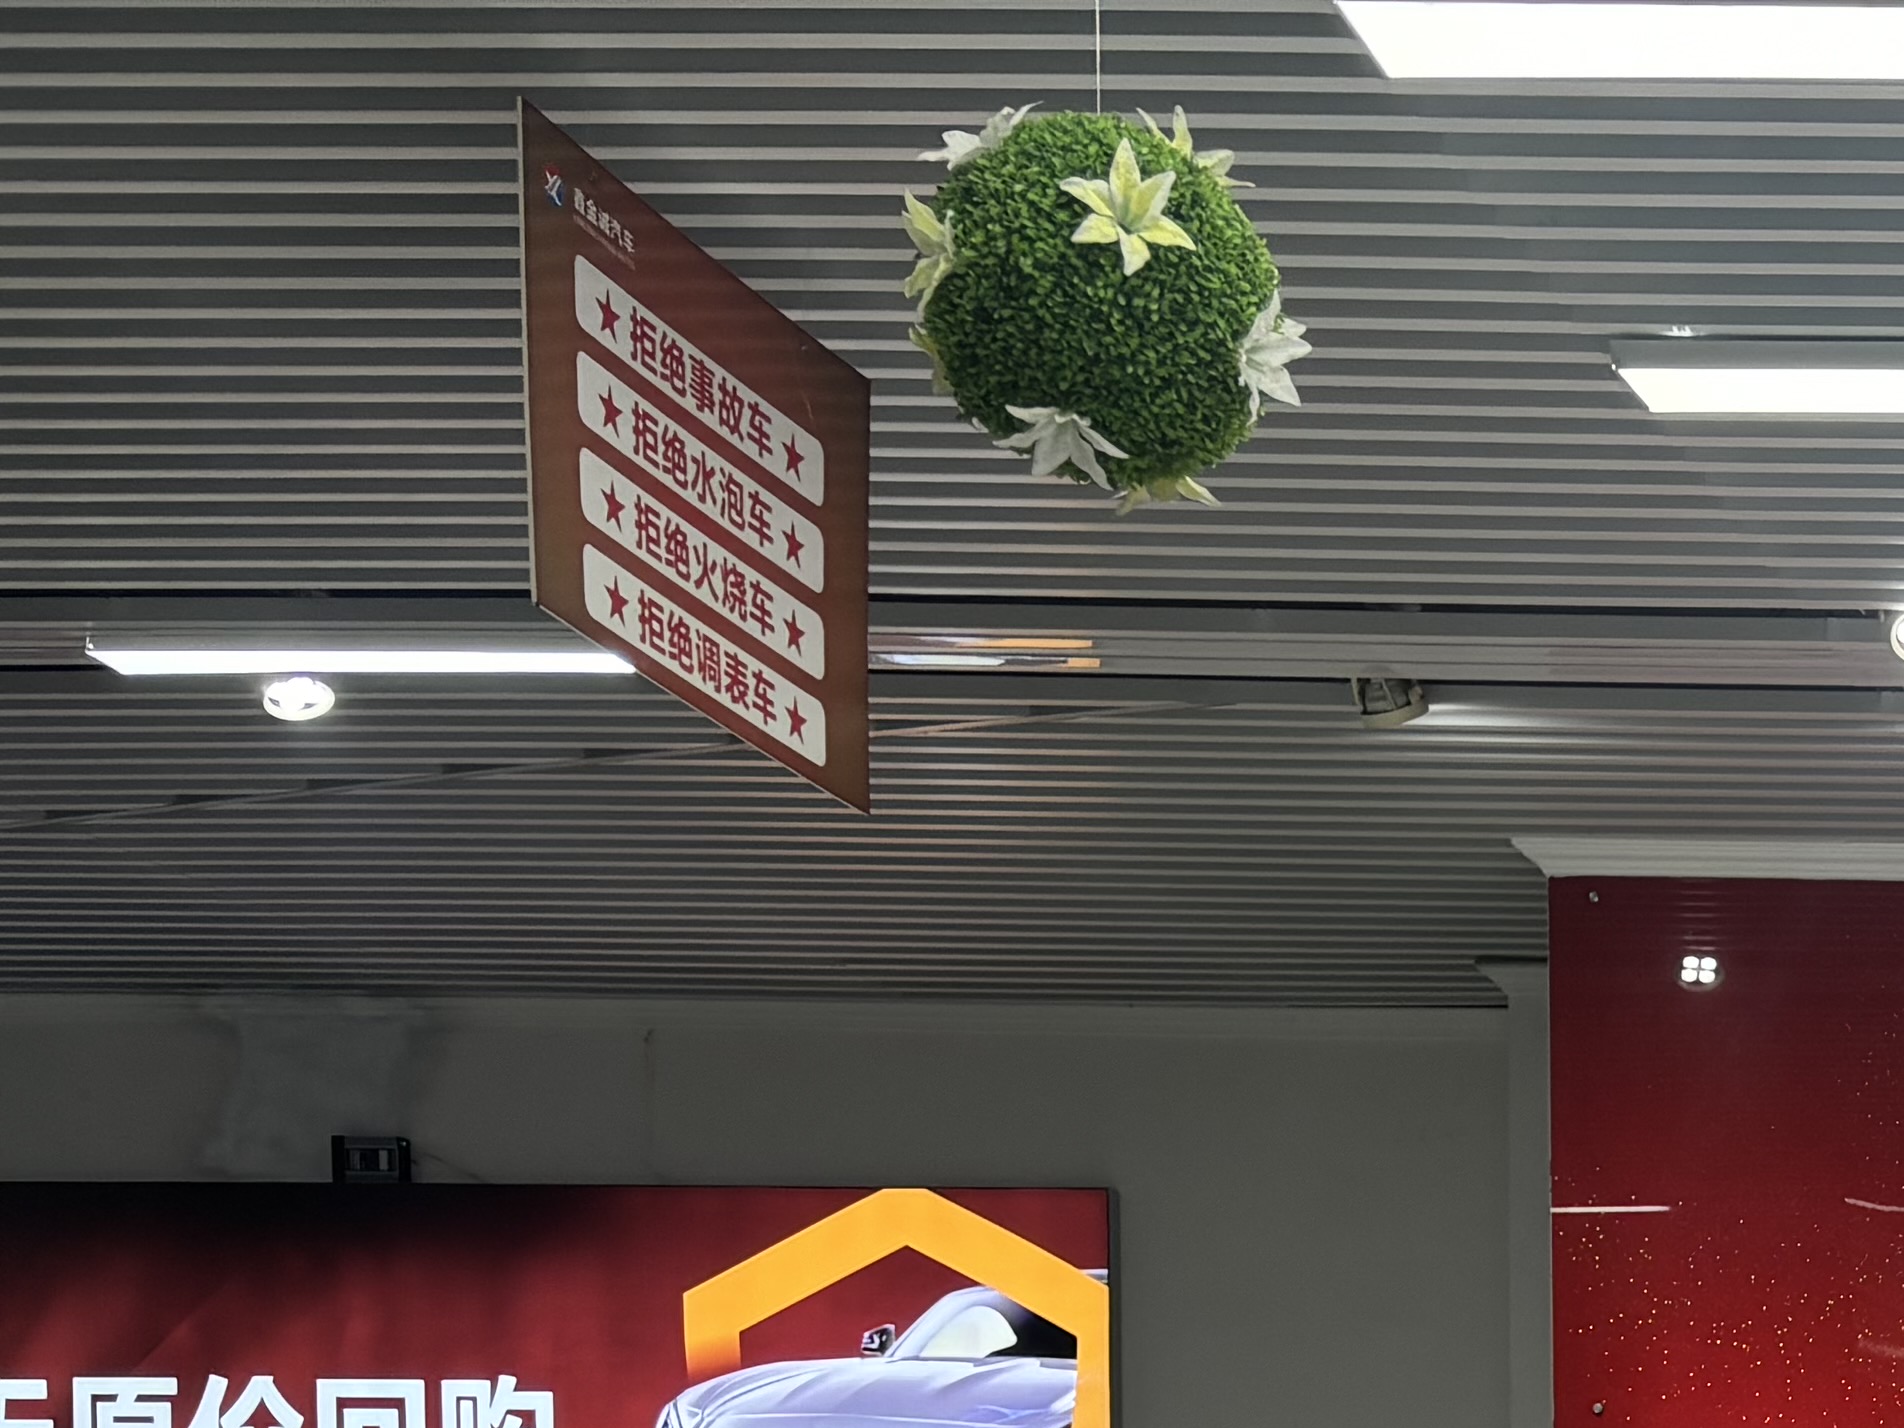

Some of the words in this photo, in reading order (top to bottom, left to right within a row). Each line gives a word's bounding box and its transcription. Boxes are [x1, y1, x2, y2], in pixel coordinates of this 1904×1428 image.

[628, 304, 775, 461] 拒绝事故车
[631, 401, 776, 550] 拒绝水泡车
[633, 493, 777, 638] 拒绝火烧车
[636, 587, 778, 728] 拒绝调表车
